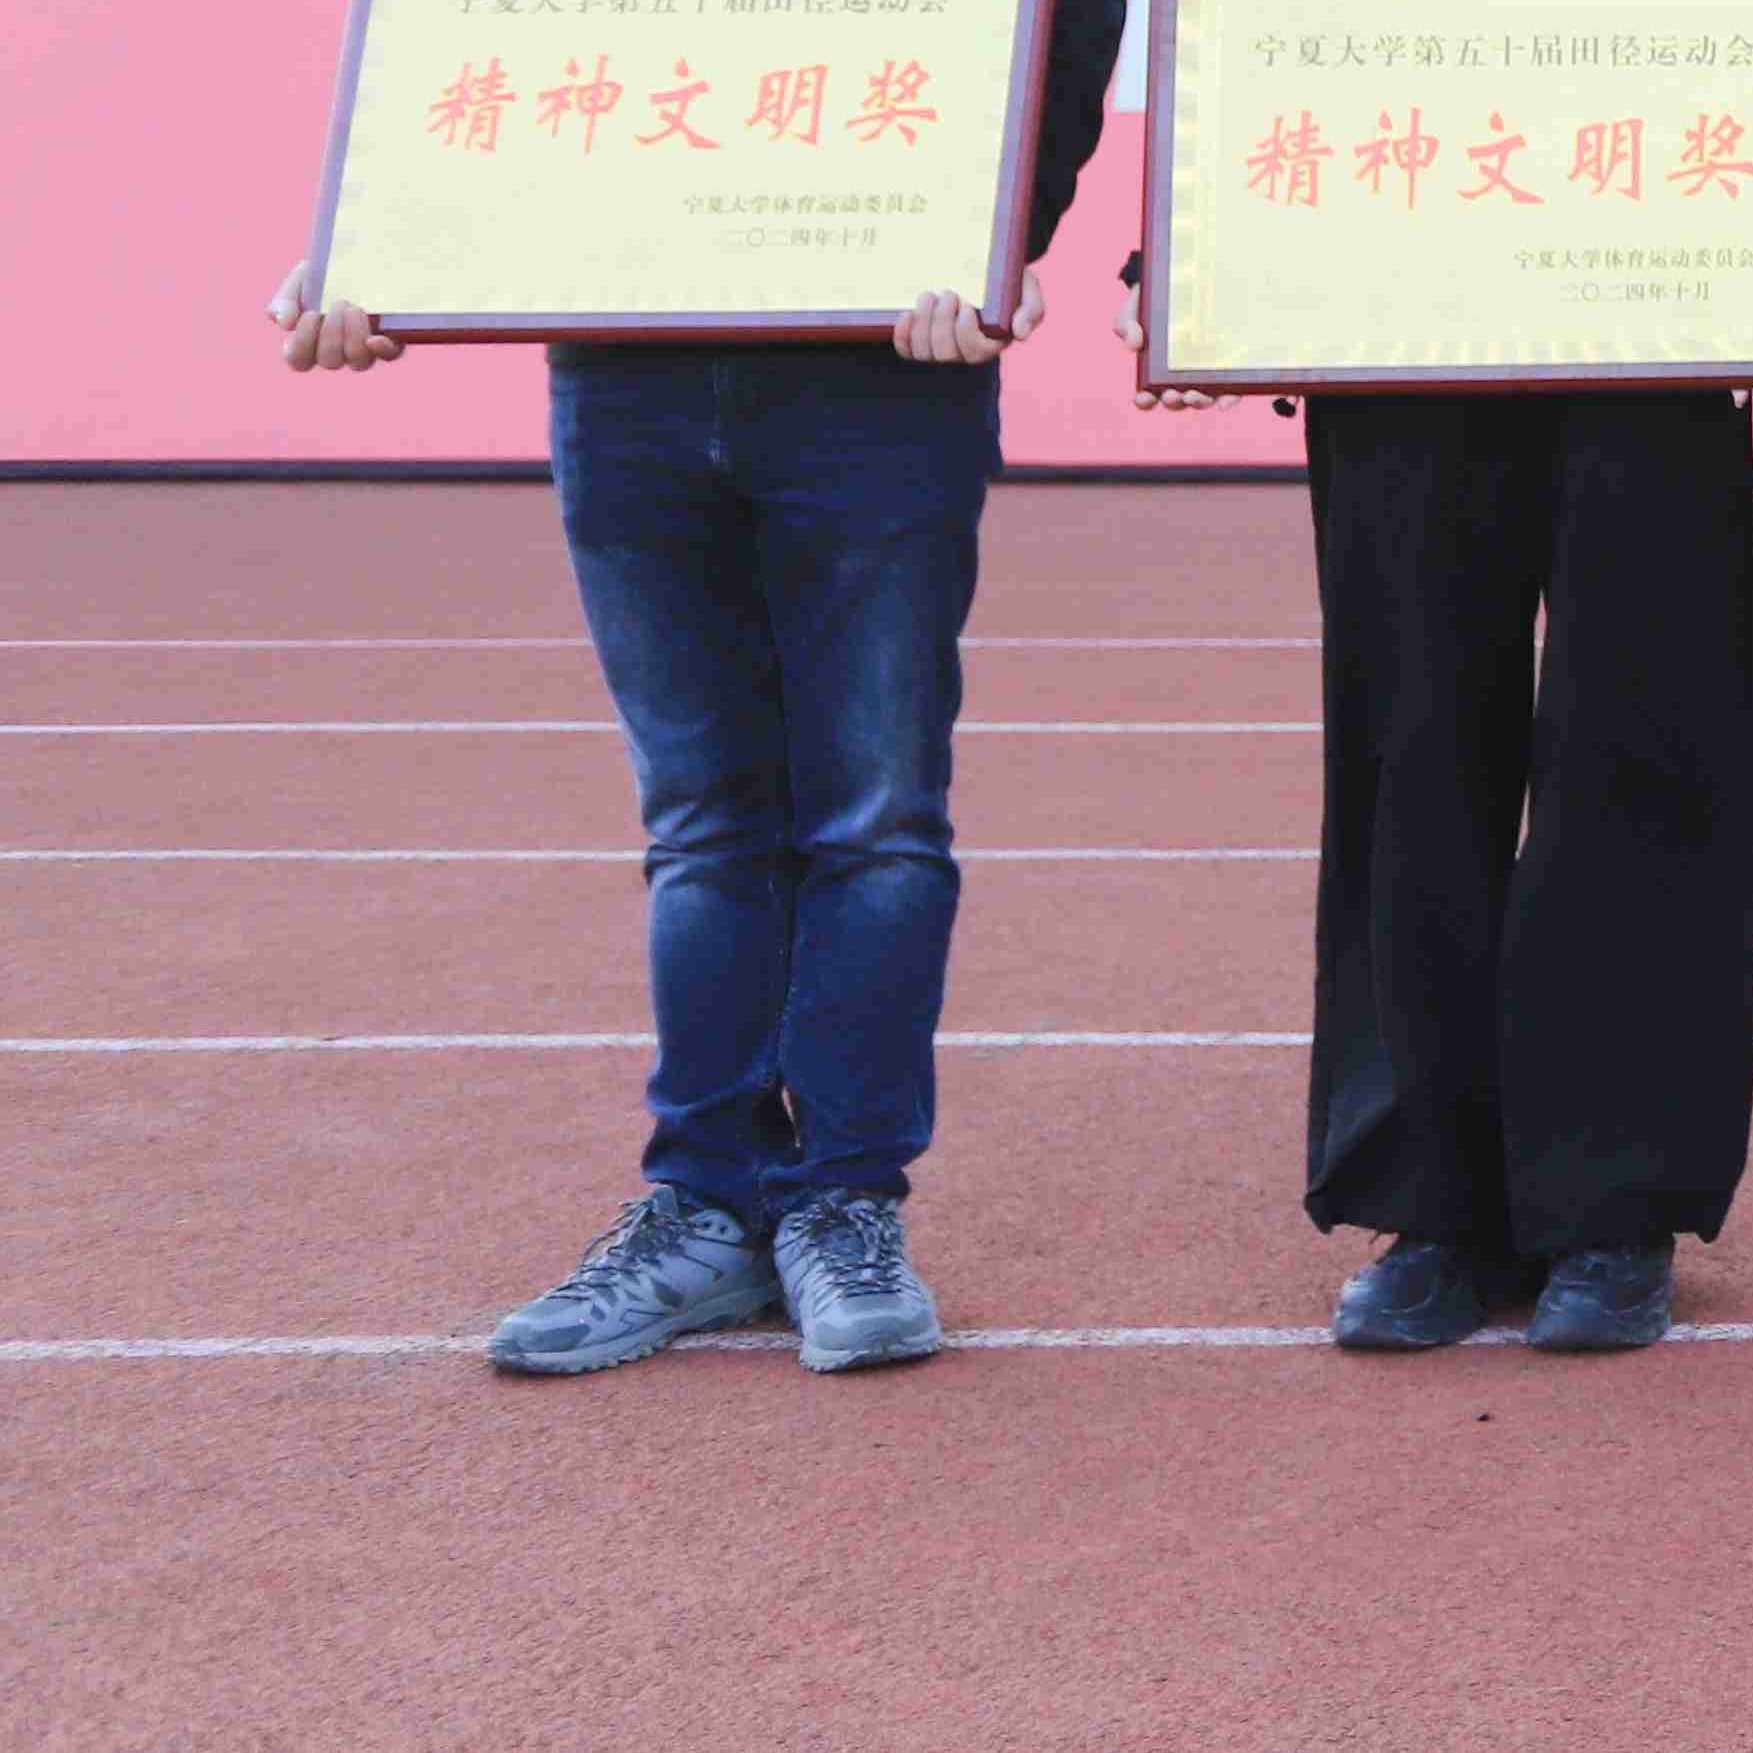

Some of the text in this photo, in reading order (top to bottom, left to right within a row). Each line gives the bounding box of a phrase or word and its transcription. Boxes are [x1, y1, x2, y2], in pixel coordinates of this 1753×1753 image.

[427, 55, 937, 153] 精神文明奖
